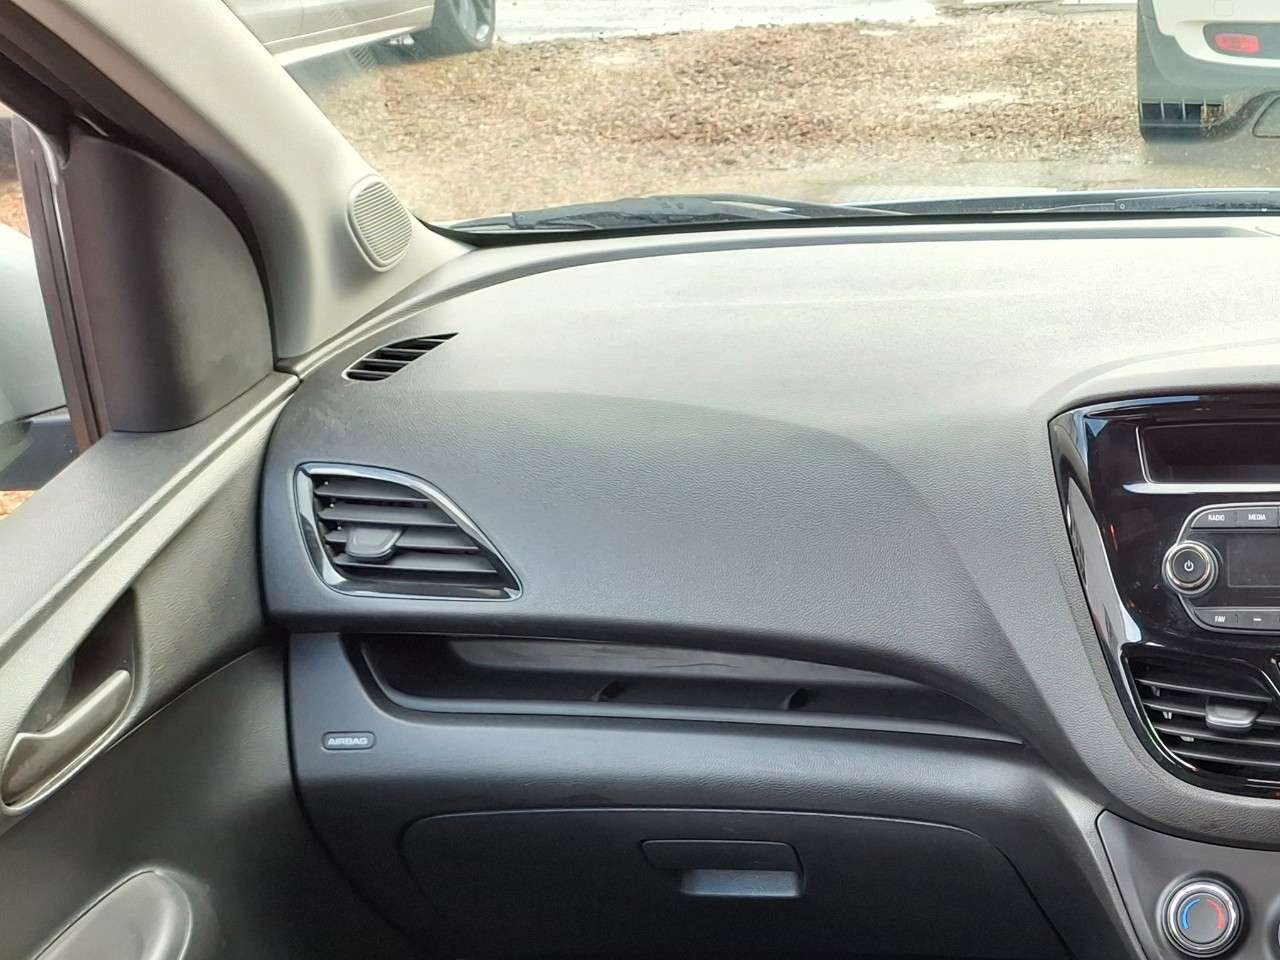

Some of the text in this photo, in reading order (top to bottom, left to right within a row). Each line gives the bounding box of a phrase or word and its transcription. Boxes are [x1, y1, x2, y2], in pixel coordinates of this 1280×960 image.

[1207, 513, 1226, 522] RADIO
[1247, 513, 1267, 521] MEDIA
[1214, 615, 1226, 623] FAV
[327, 737, 369, 746] AIRBAG
